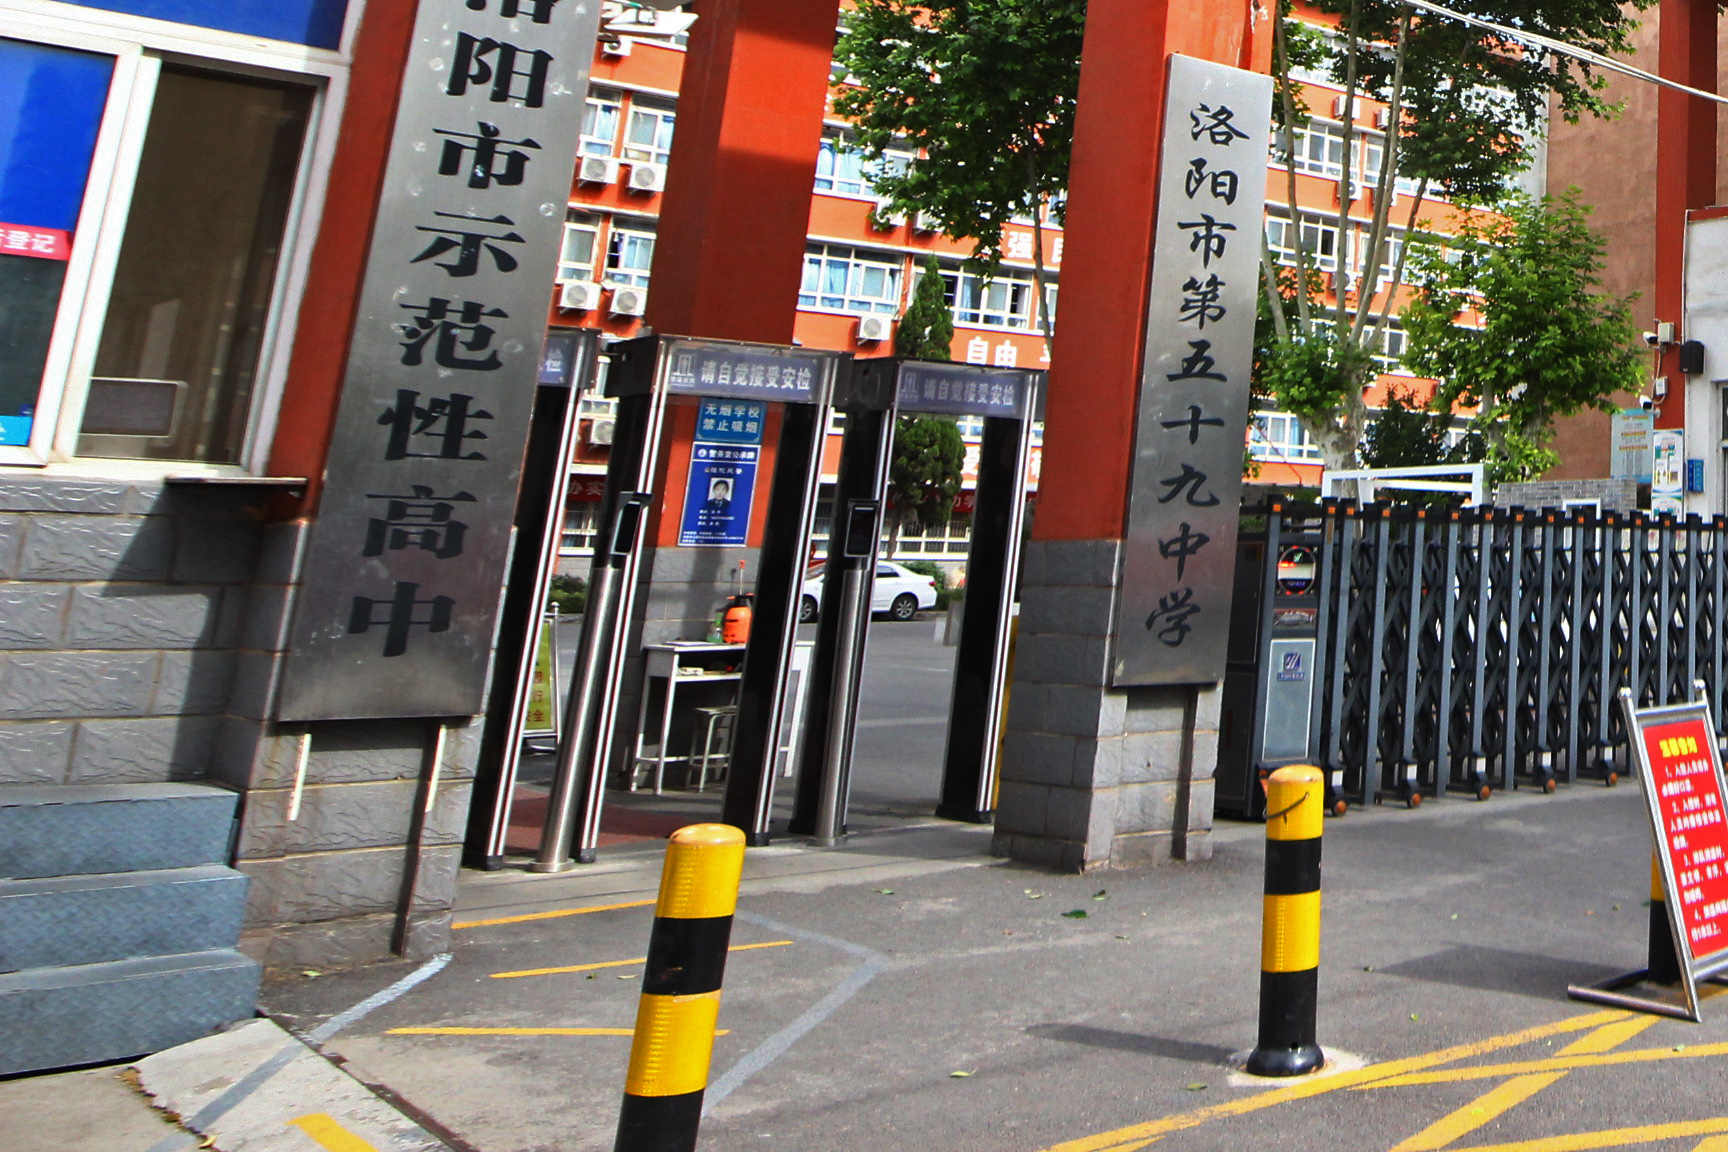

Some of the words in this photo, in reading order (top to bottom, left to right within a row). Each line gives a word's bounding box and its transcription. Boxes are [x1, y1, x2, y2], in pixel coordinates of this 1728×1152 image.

[967, 336, 1017, 368] 自由
[701, 360, 812, 391] 请自觉接受安检
[1145, 102, 1250, 648] 洛阳市第五十九中学
[924, 379, 1015, 406] 请自觉接受安检
